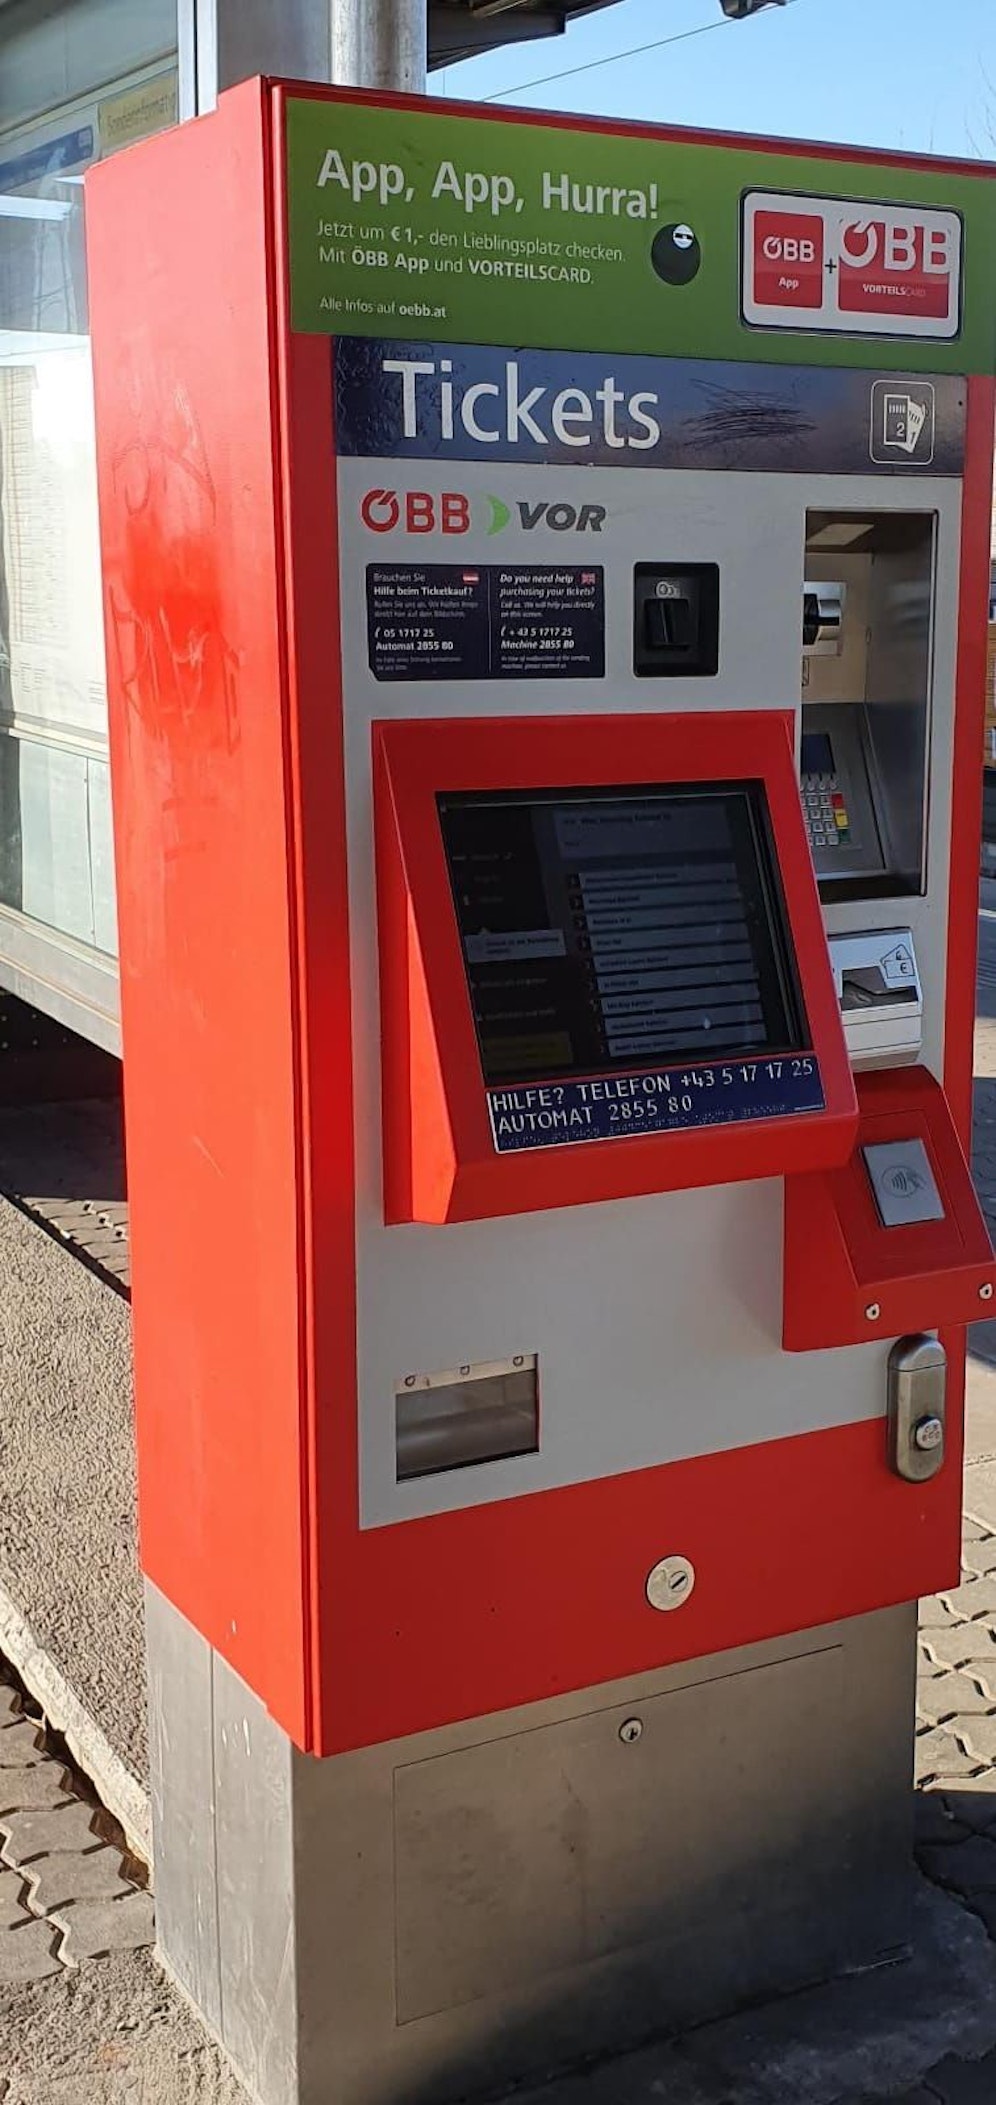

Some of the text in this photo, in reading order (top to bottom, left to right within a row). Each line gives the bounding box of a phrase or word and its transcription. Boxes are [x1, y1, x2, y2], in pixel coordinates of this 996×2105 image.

[317, 149, 659, 220] App, App, Hurra!
[317, 220, 355, 239] Jetzt
[360, 227, 384, 240] um
[429, 230, 457, 248] den
[463, 231, 560, 256] Lieblingsplatz
[565, 240, 626, 262] checken.
[762, 236, 815, 263] ÖBB
[839, 218, 951, 275] ÖBB
[319, 247, 594, 284] Mit ÖBB App und VORTEILSCARD.
[778, 276, 800, 290] App
[862, 283, 927, 298] VORTEILSCARD
[320, 296, 446, 318] Alle Infos auf oebb.at
[382, 359, 663, 450] Tickets
[360, 488, 471, 535] ÖBB
[515, 500, 607, 533] VOR
[373, 572, 426, 583] Brauchen Sie
[500, 573, 574, 586] Do you need help
[374, 585, 474, 596] Hilfe beim Ticketkauf?
[499, 586, 596, 598] purchasing your tickets?
[383, 629, 435, 638] 05 1717 25
[517, 627, 529, 637] 43
[540, 627, 560, 637] 1717
[561, 627, 573, 636] 25
[375, 641, 415, 651] Automat
[417, 641, 440, 651] 2855
[501, 640, 538, 650] Machine
[539, 640, 562, 650] 2855
[493, 1058, 814, 1112] HILFE? TELEFON +43 5 17 17 25
[498, 1094, 692, 1135] AUTOMAT 2855 80
